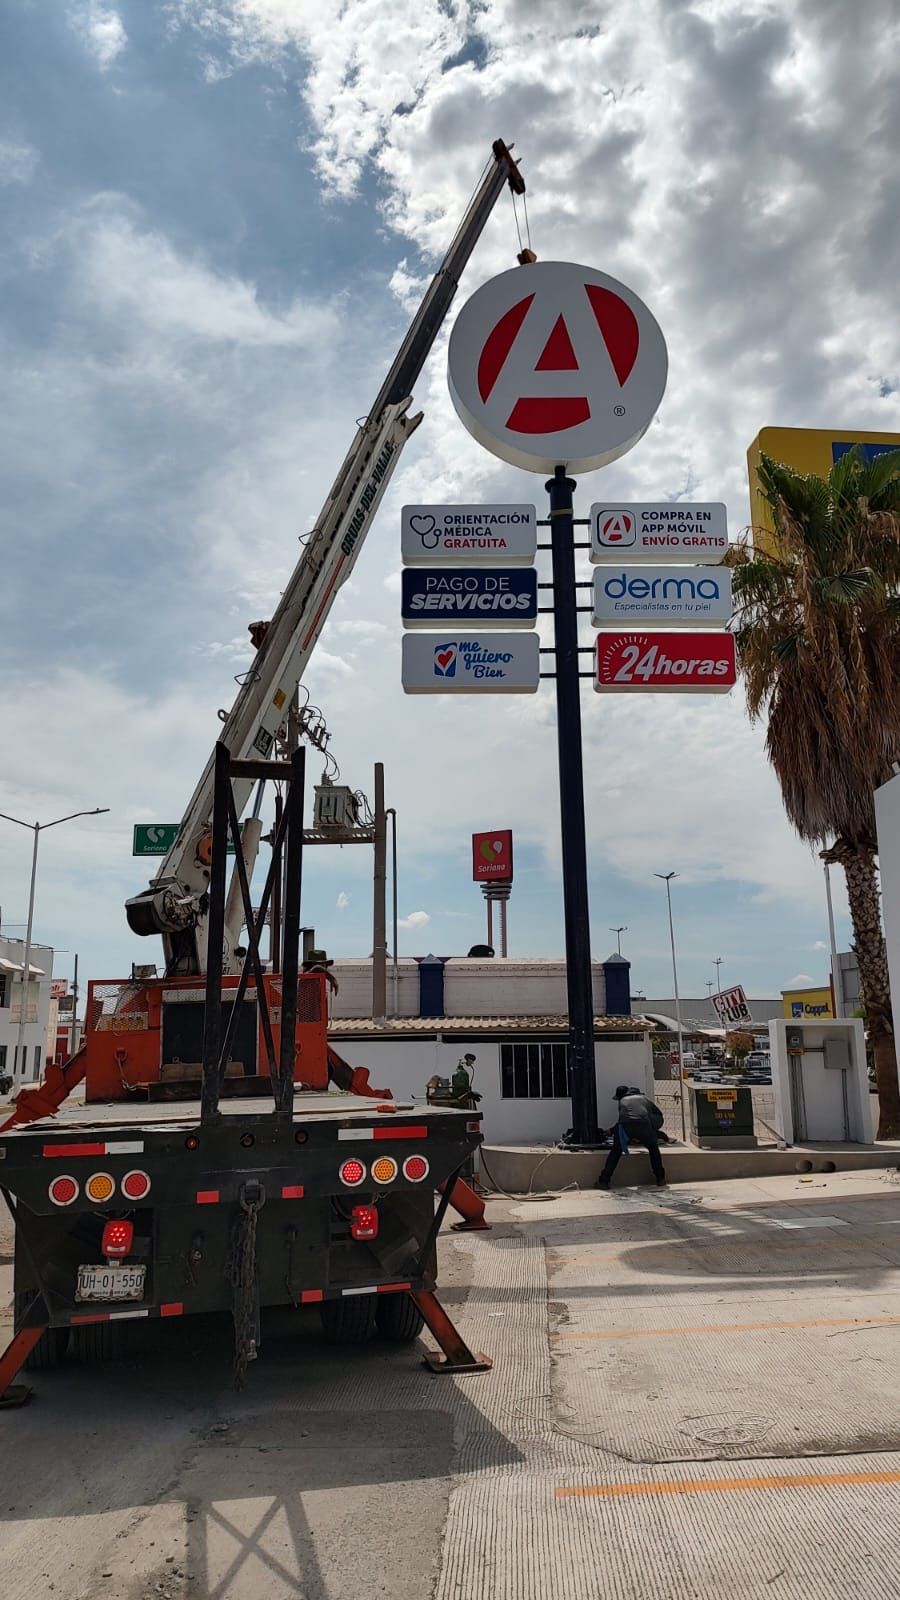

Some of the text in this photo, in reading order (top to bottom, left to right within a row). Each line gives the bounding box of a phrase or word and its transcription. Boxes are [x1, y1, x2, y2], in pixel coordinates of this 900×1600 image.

[444, 512, 530, 525] ORIENTACIÓN
[641, 511, 711, 521] COMPRA EN
[444, 525, 492, 537] MÉDICA
[641, 522, 706, 533] APP MÓVIL
[444, 538, 507, 549] GRATUITA
[642, 534, 725, 547] ENVÍO GRATIS
[426, 577, 510, 591] PAGO DE
[604, 573, 720, 599] derma
[409, 593, 532, 610] SERVICIOS
[614, 602, 670, 612] Especialistas
[684, 602, 694, 611] tu
[695, 602, 711, 612] piel
[458, 641, 482, 653] me
[463, 649, 513, 670] quiero
[472, 664, 507, 679] Bien
[478, 863, 506, 873] Soriana
[715, 990, 741, 1010] CITY
